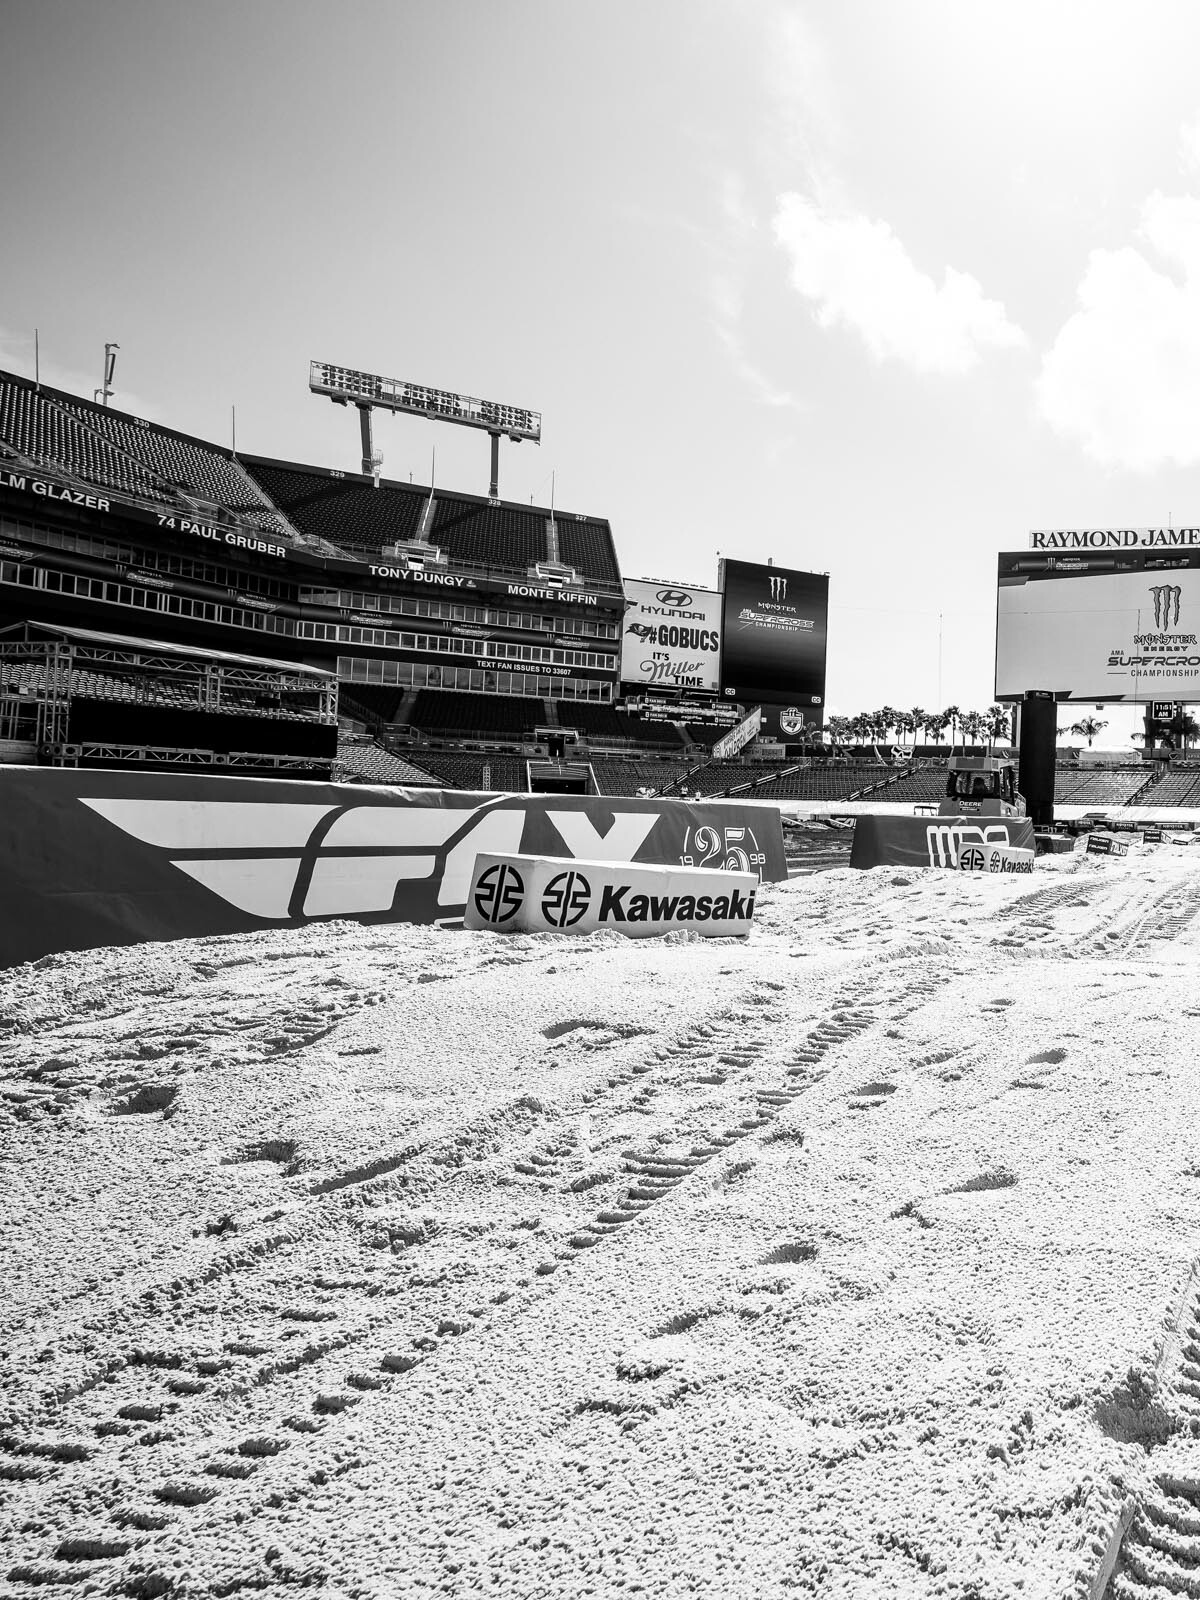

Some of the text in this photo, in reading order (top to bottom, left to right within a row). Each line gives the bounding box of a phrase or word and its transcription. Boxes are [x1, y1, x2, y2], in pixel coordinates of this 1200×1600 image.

[134, 417, 150, 428] 330
[330, 470, 345, 478] 329
[31, 481, 110, 512] GLAZER
[157, 514, 286, 558] 74 PAUL GRUBER
[1032, 530, 1138, 548] RAYMOND
[369, 565, 464, 588] TONY DUNGY
[507, 584, 597, 605] MONTE KIFFIN
[640, 605, 706, 621] HYUNDAI
[758, 602, 797, 613] MONSTER
[755, 621, 798, 631] CHAMPIONSHIP
[649, 624, 719, 652] #GOBUCS
[1133, 632, 1198, 646] MONSTER
[652, 651, 670, 661] IT'S
[514, 664, 540, 672] ISSUES
[541, 666, 552, 674] TO
[640, 659, 705, 681] Miller
[1130, 669, 1200, 677] CHAMPIONSHIP
[673, 675, 704, 687] TIME
[694, 826, 751, 872] 25
[679, 855, 694, 867] 19
[749, 853, 766, 864] 98
[1000, 857, 1035, 874] Kawasaki
[598, 885, 755, 922] Kawasaki
